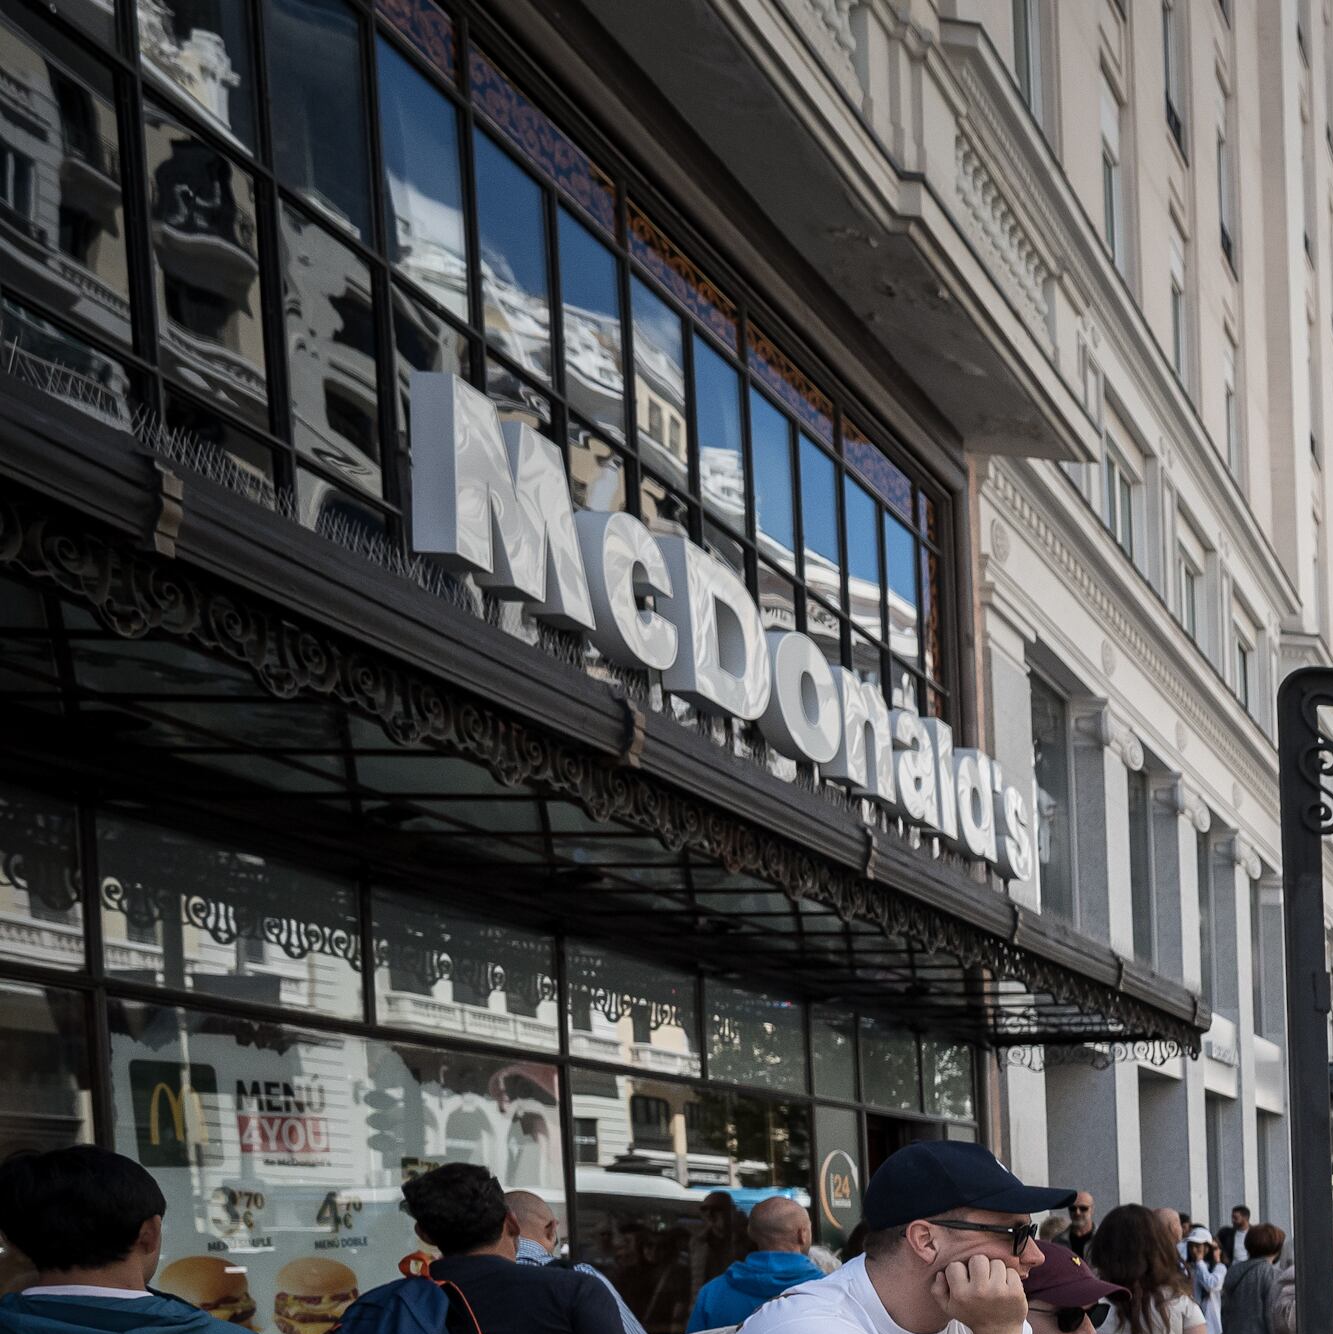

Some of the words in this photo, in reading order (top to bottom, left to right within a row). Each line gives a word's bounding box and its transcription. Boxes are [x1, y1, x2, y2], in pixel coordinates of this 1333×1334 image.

[410, 371, 1034, 881] McDonald's
[236, 1074, 326, 1114] MENÚ
[242, 1118, 328, 1151] 4YOU
[833, 1173, 850, 1199] 24
